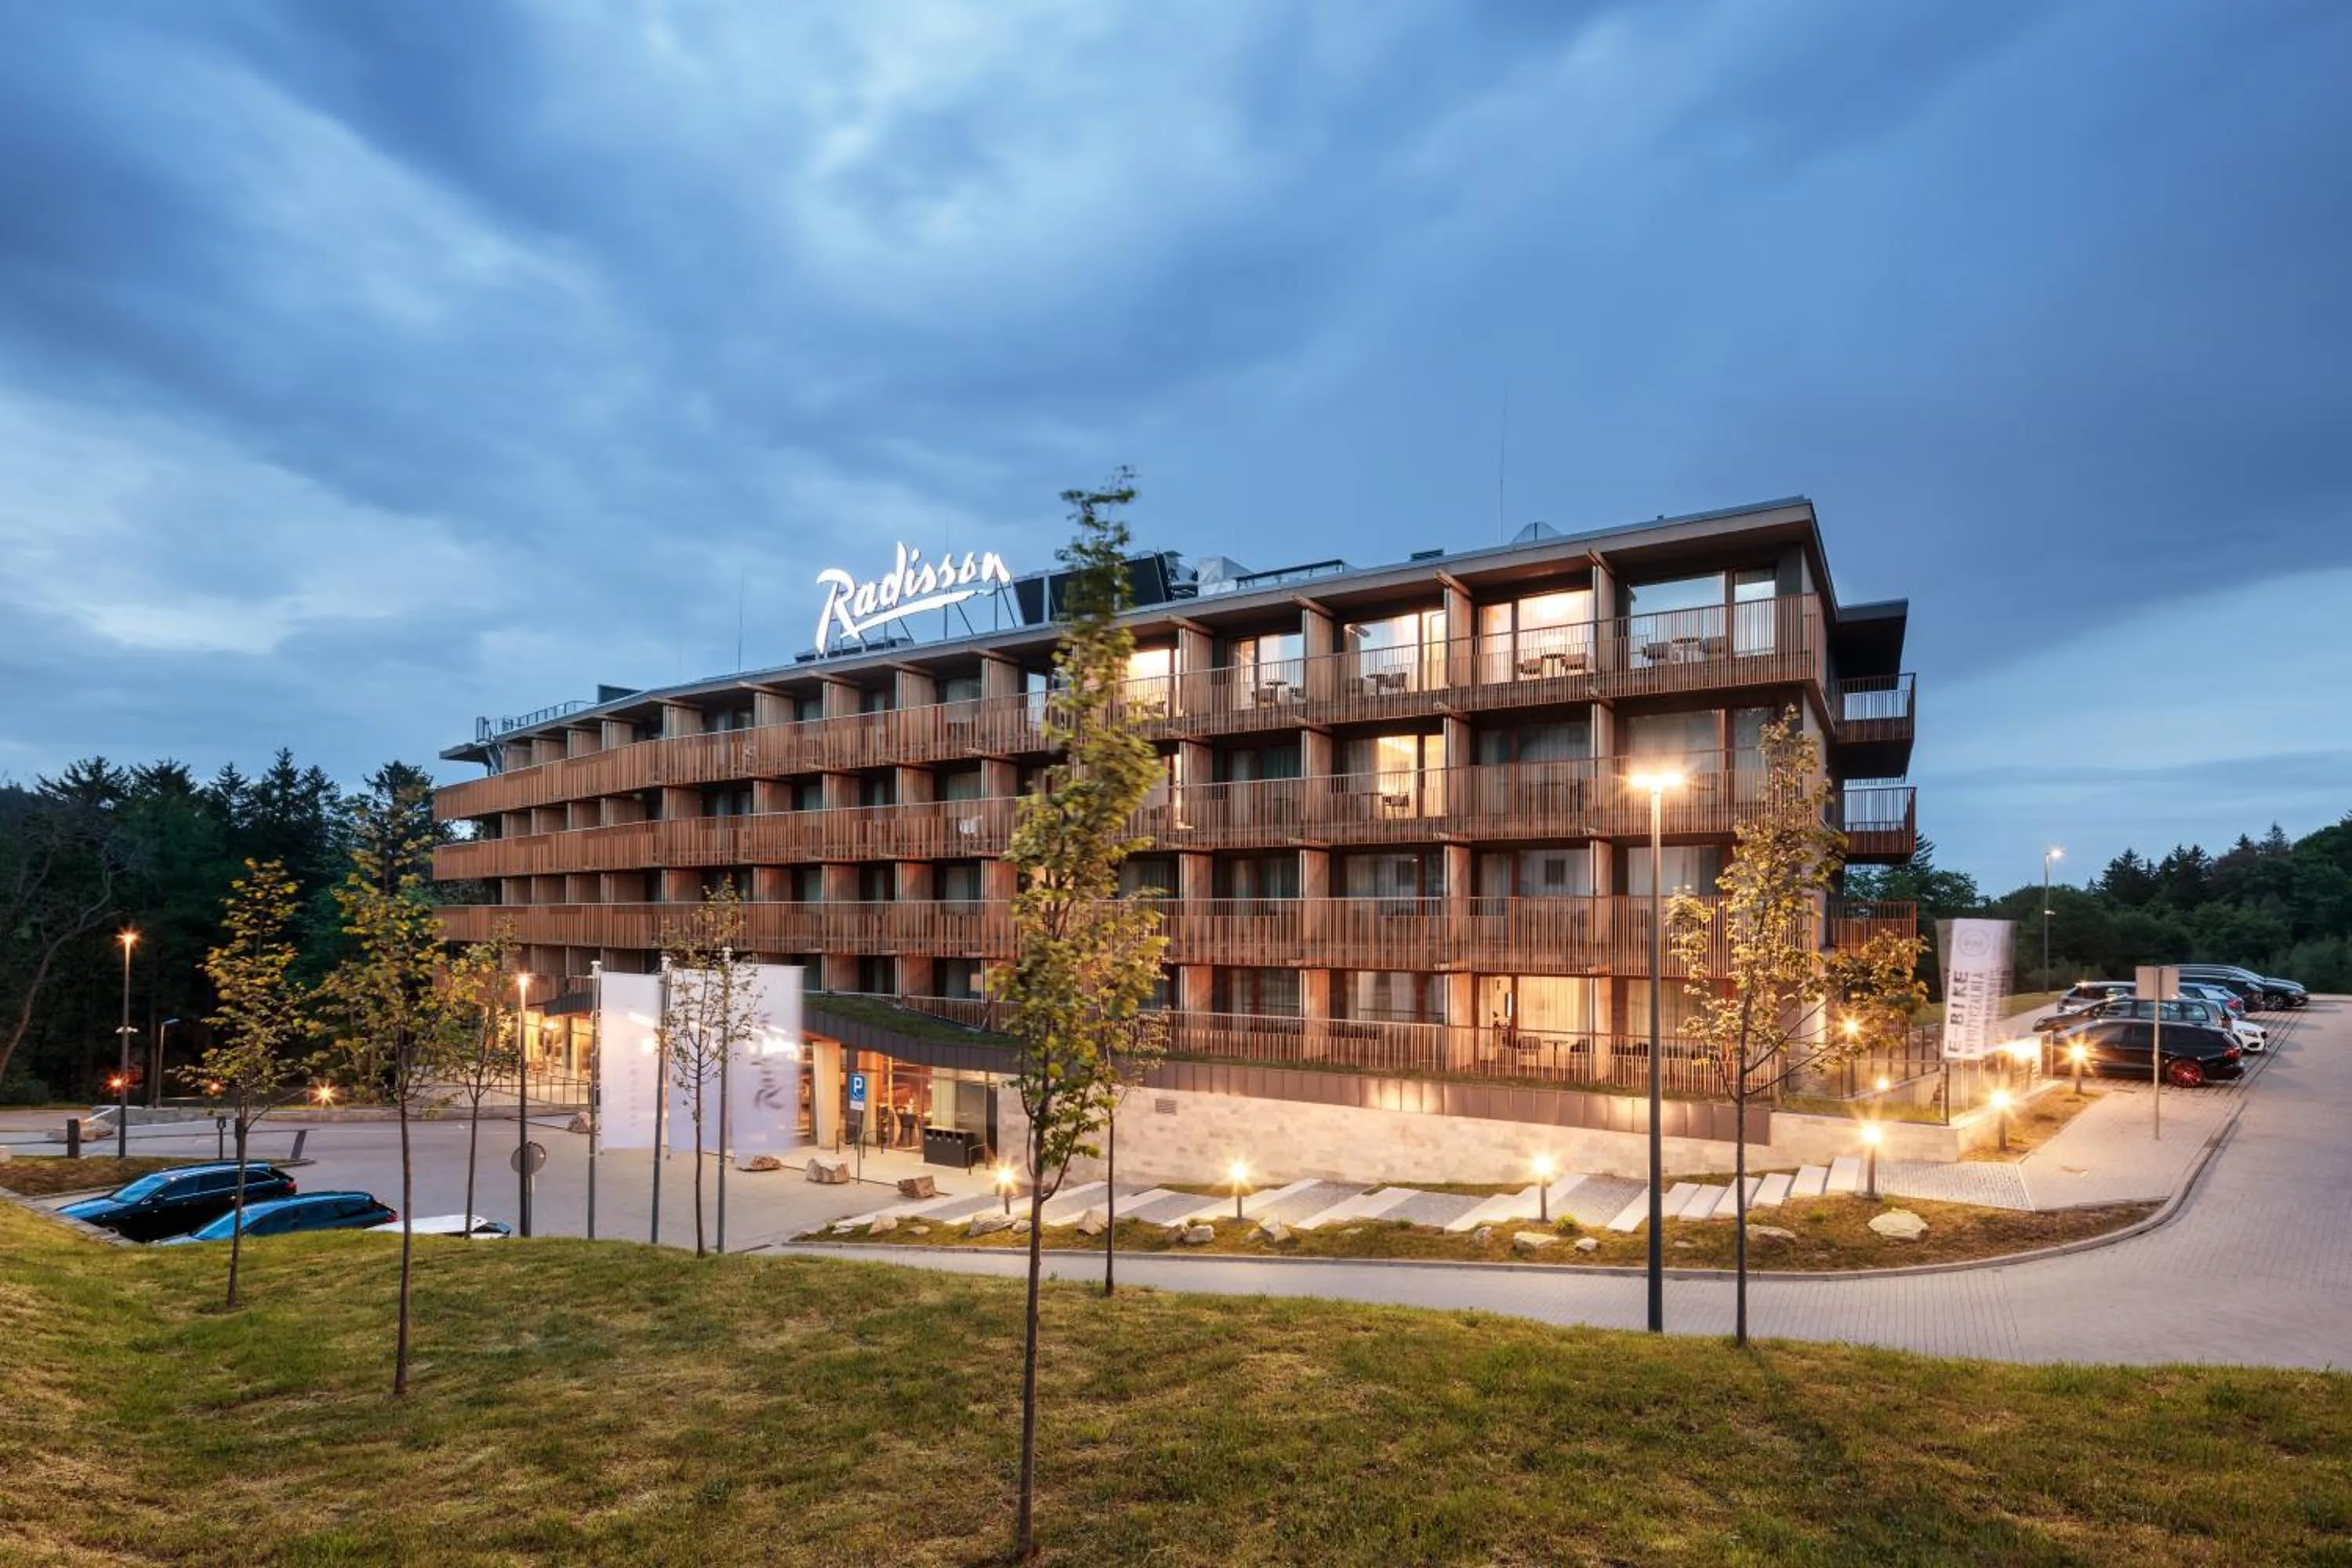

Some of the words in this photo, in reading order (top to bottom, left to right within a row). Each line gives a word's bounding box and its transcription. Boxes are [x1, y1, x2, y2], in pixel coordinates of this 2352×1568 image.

[816, 541, 1011, 654] Radisson
[1947, 970, 1968, 1052] E-BIKE
[854, 1076, 862, 1093] P
